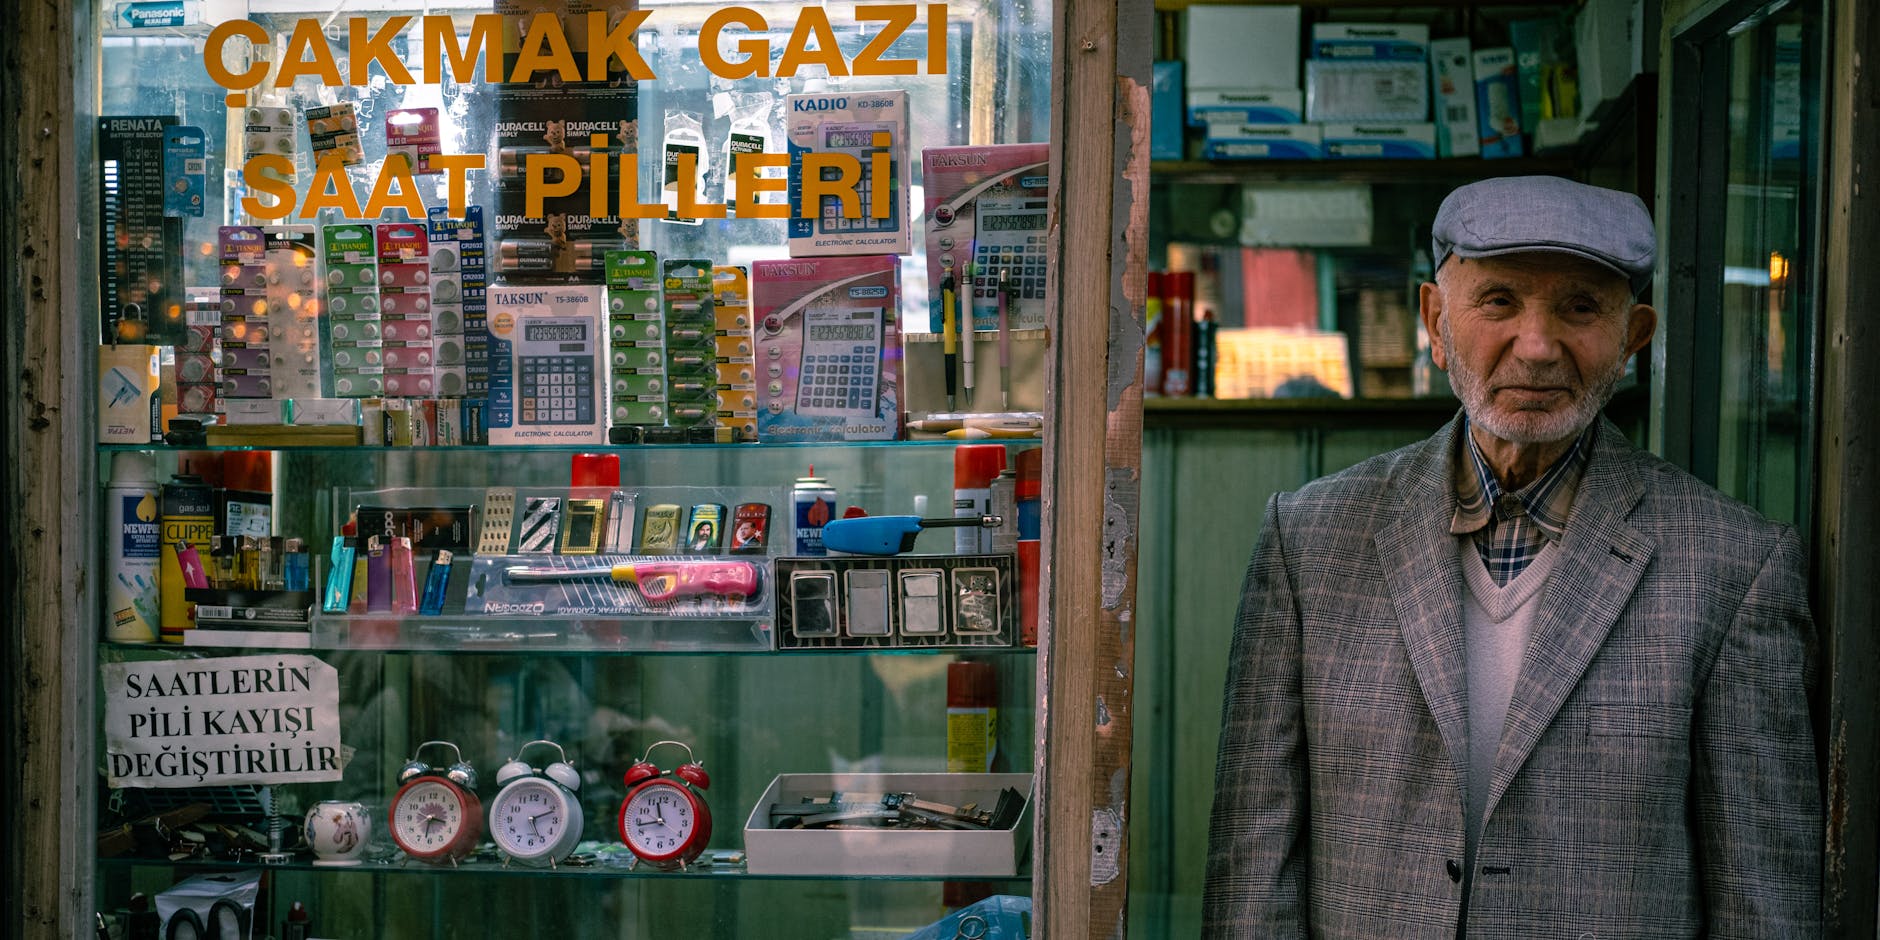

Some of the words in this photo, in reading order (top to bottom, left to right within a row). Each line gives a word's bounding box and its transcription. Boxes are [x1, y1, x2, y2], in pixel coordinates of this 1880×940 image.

[131, 7, 185, 19] Panasonic
[143, 18, 172, 26] ALKALINE
[203, 10, 657, 108] ÇAKMAK
[698, 3, 948, 80] GAZI
[794, 97, 847, 112] KADIO
[110, 119, 163, 131] RENATA
[495, 122, 545, 132] DURACELL
[566, 121, 618, 131] DURACELL
[929, 152, 986, 168] TAKSUN
[241, 153, 486, 220] SAAT
[525, 132, 892, 219] PİLLERİ
[495, 215, 546, 224] DURACELL
[567, 215, 619, 224] DURACELL
[815, 239, 853, 247] ELECTRONIC
[759, 262, 816, 277] TAKSUN
[665, 278, 682, 289] GP
[495, 293, 543, 305] TAKSUN
[472, 407, 480, 442] Panasonic
[830, 423, 887, 434] calculator
[178, 504, 194, 514] gas
[123, 523, 160, 534] NEWPO
[166, 524, 214, 540] CLIPPE
[484, 602, 545, 616] ÖZDOĞAN
[557, 606, 596, 614] ÇAKMAĞI
[598, 606, 631, 614] MUTFAK
[126, 661, 311, 699] SAATLERİN
[128, 705, 192, 738] PİLİ
[202, 706, 316, 739] KAYIŞI
[112, 740, 339, 782] DEĞİŞTİRİLİR
[519, 796, 526, 804] 11
[659, 796, 669, 804] 12
[511, 805, 521, 813] 10
[640, 807, 650, 815] 10
[680, 808, 686, 816] 2
[635, 817, 641, 826] 9
[509, 826, 515, 834] 8
[547, 827, 553, 835] 4
[677, 830, 682, 838] 4
[516, 835, 522, 843] 7
[645, 837, 651, 845] 7
[669, 838, 675, 846] 5
[657, 841, 663, 849] 6
